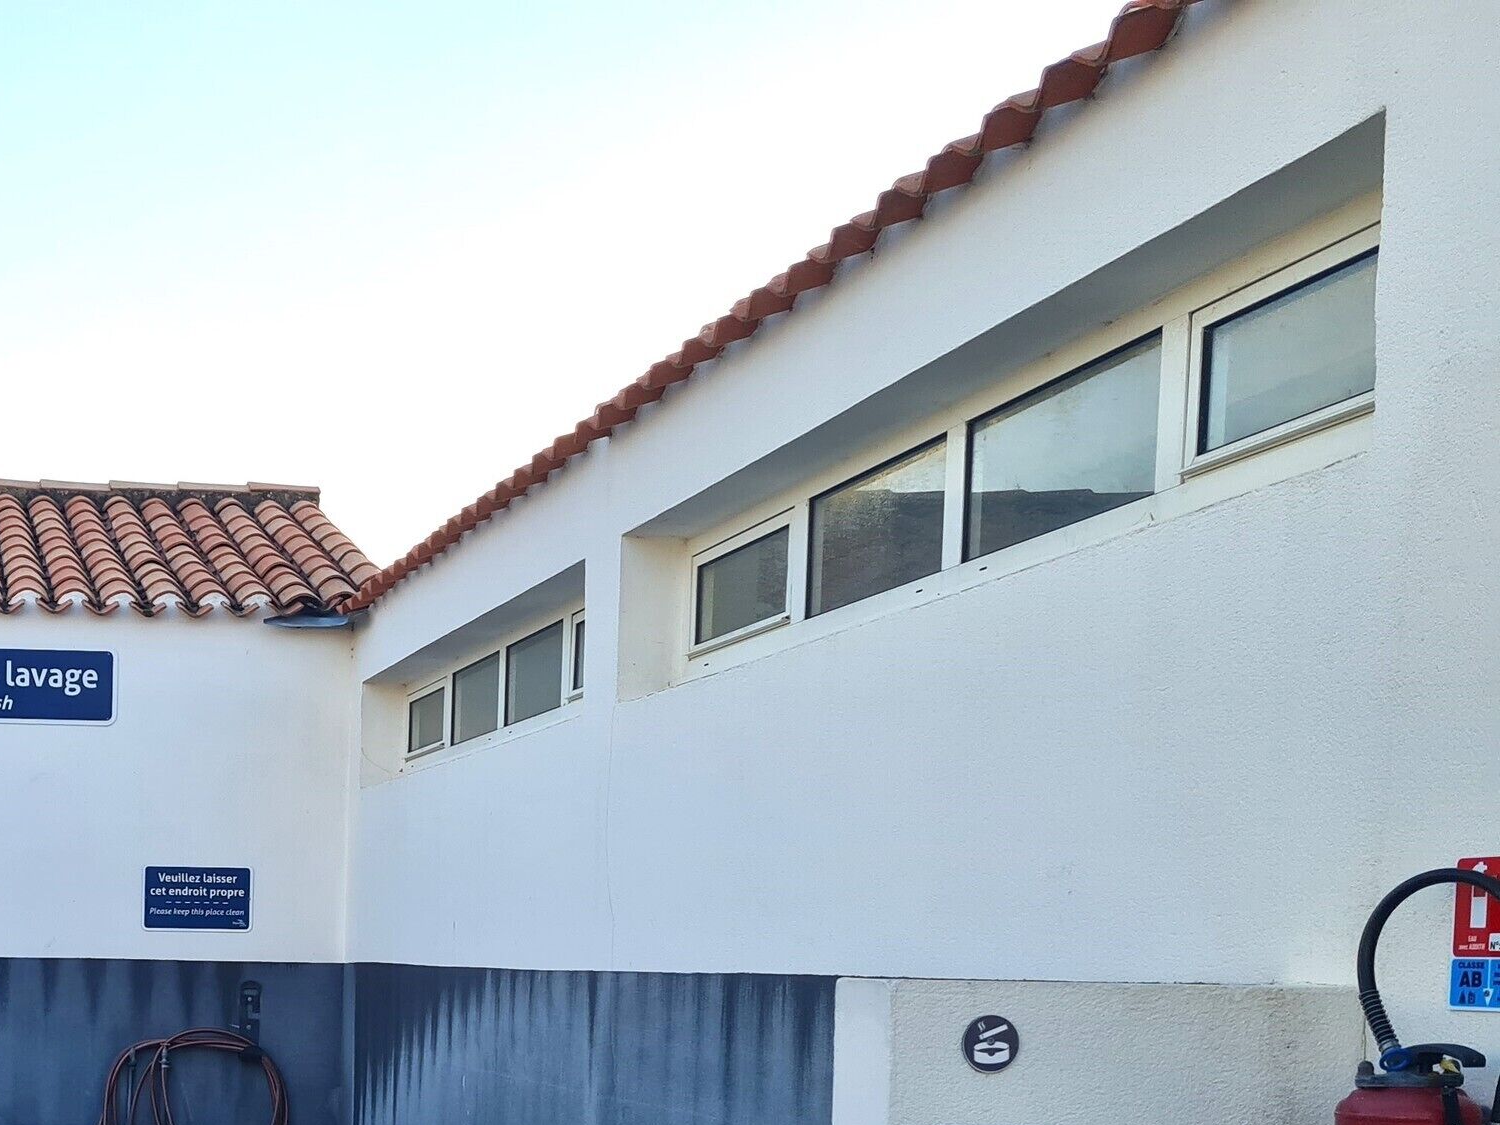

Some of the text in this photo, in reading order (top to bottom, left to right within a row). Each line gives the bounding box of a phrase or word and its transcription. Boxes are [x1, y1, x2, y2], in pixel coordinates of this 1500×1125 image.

[6, 660, 99, 696] lavage
[158, 872, 237, 884] Veuillez laisser
[150, 886, 245, 899] cet endroit propre
[149, 907, 245, 917] Please keep this place clean
[1459, 970, 1483, 988] AB
